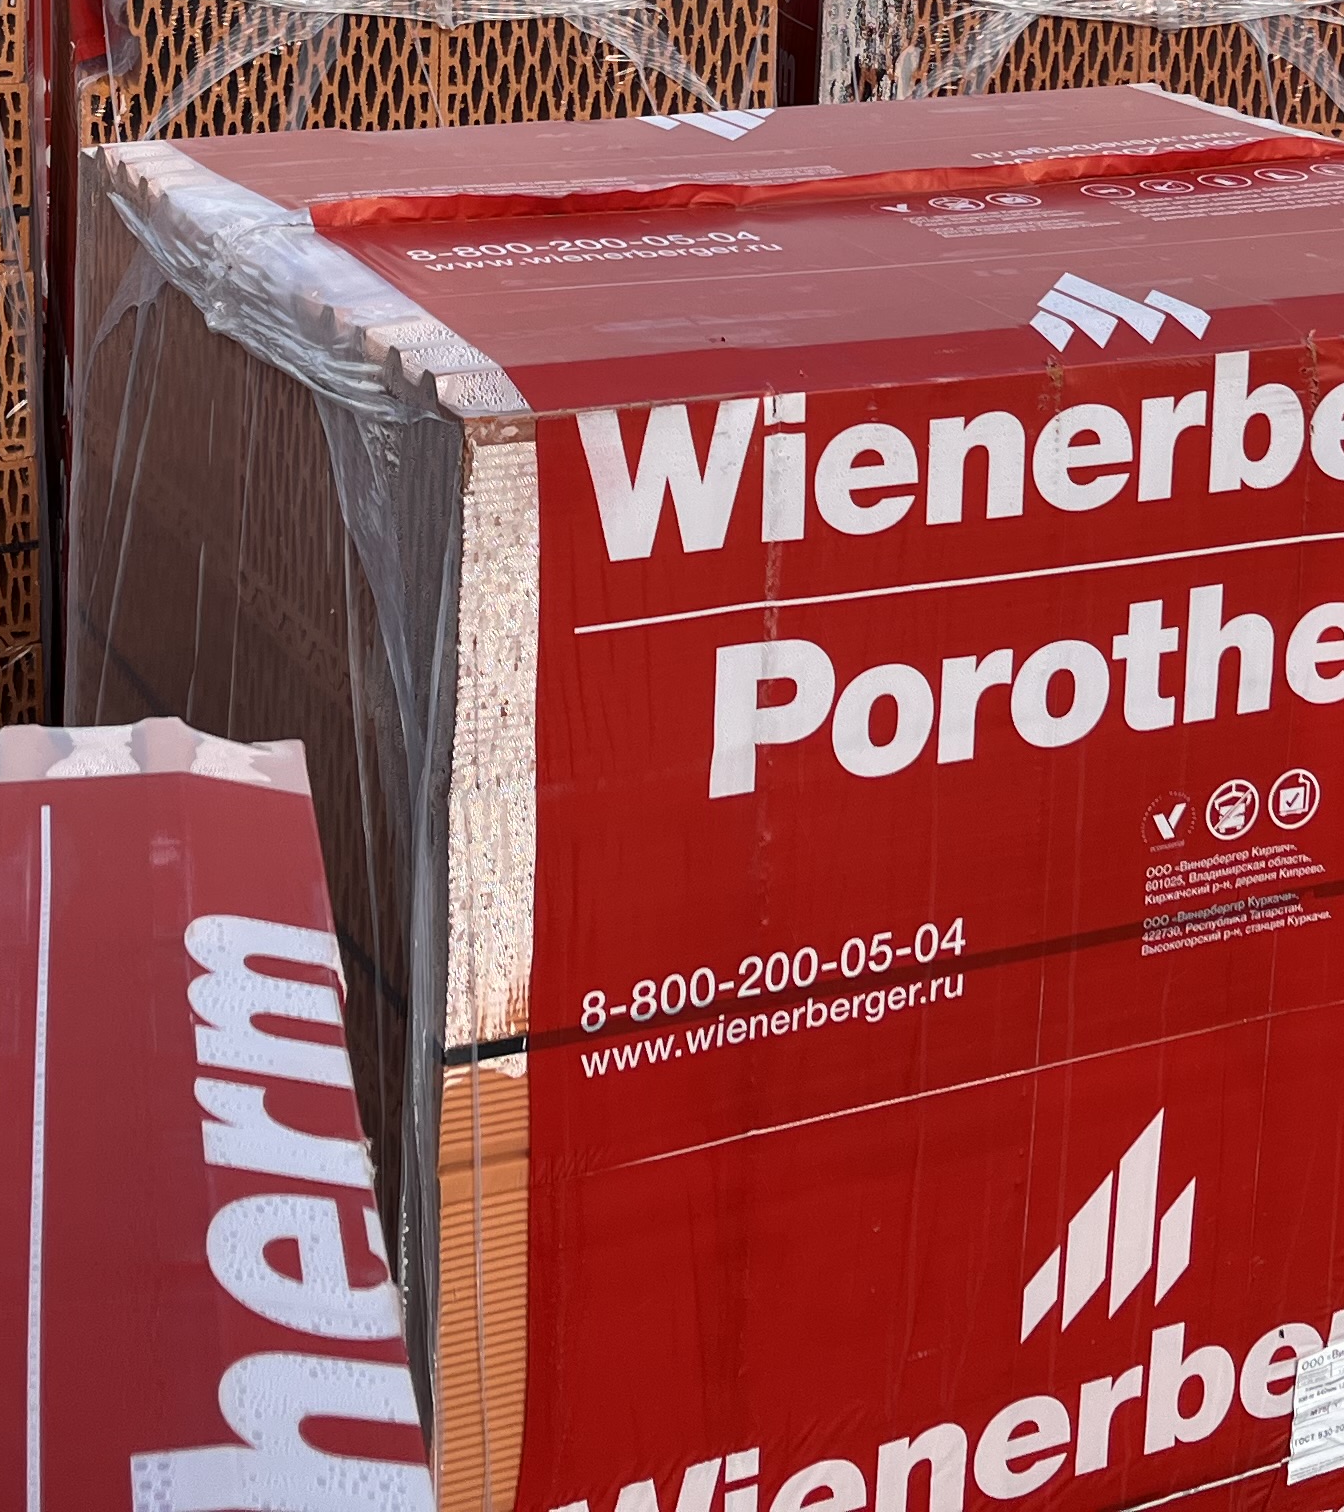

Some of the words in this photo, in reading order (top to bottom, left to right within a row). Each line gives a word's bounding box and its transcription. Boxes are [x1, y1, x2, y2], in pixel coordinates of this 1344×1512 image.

[407, 230, 761, 262] 8-800-200-05-04
[425, 243, 783, 272] www.wienerberger.ru
[1146, 863, 1172, 879] ООО
[1143, 914, 1170, 930] ООО
[580, 916, 967, 1034] 8-800-200-05-04
[580, 973, 965, 1079] www.wienerberger.ru
